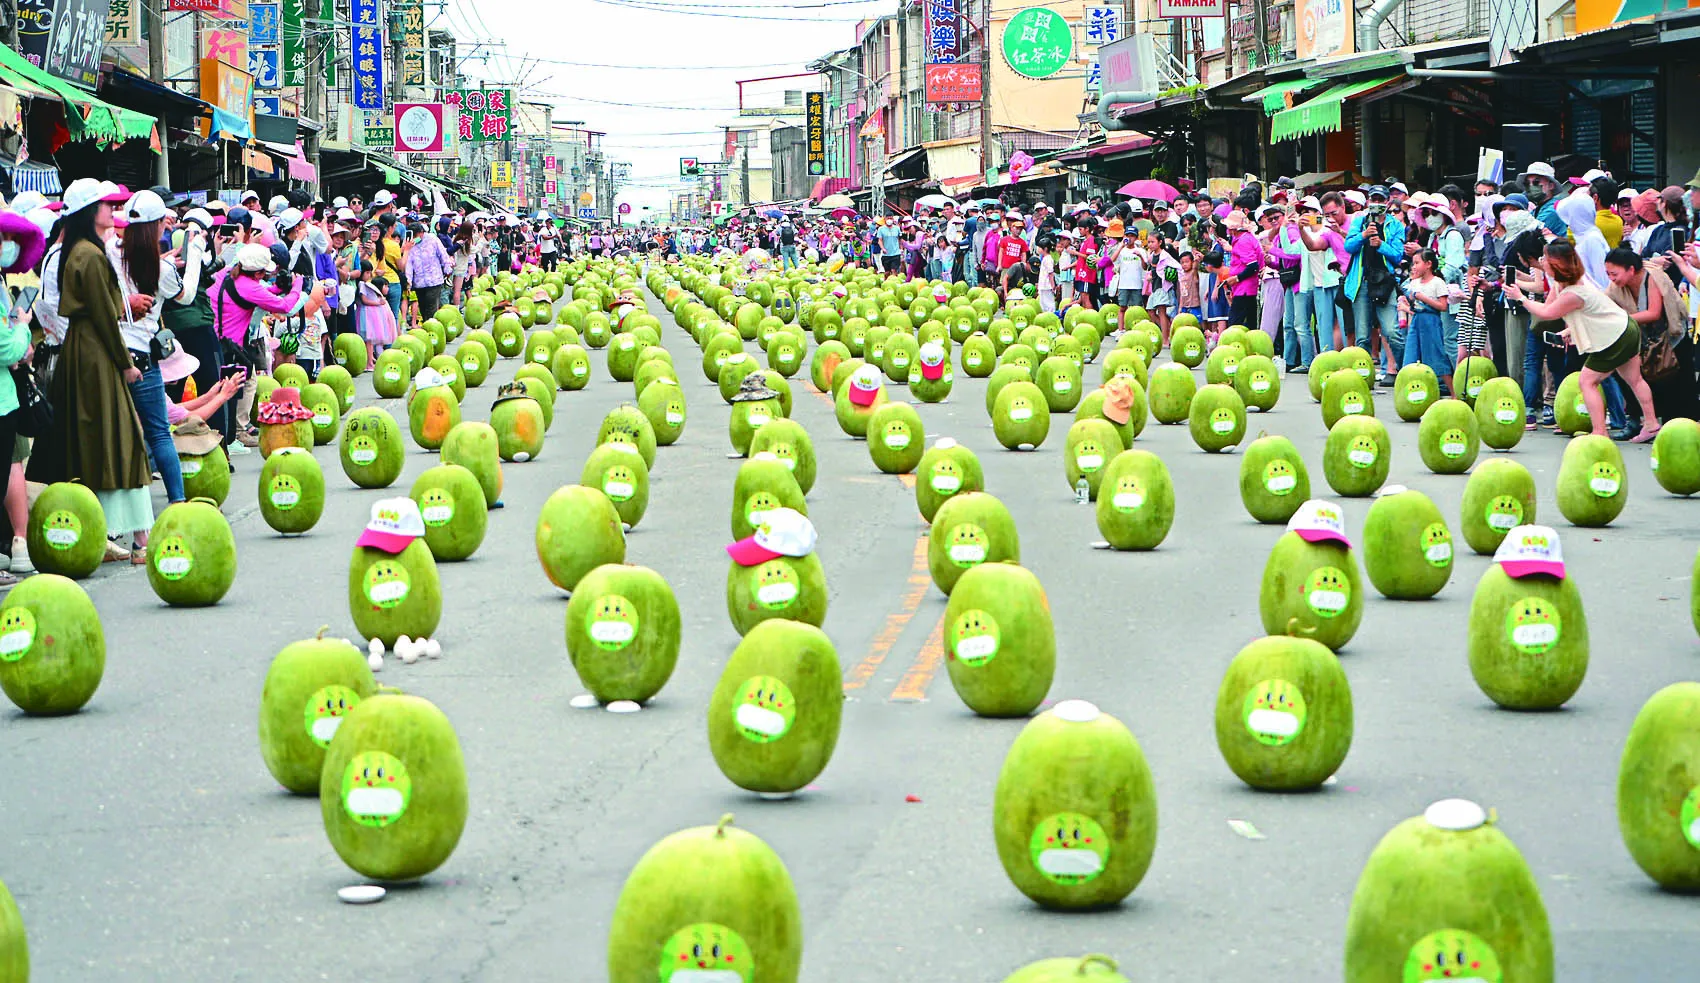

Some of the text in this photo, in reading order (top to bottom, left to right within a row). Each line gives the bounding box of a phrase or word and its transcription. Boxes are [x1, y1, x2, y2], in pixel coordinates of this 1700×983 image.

[404, 0, 422, 83] 成藥局
[1012, 45, 1067, 65] 紅茶冰
